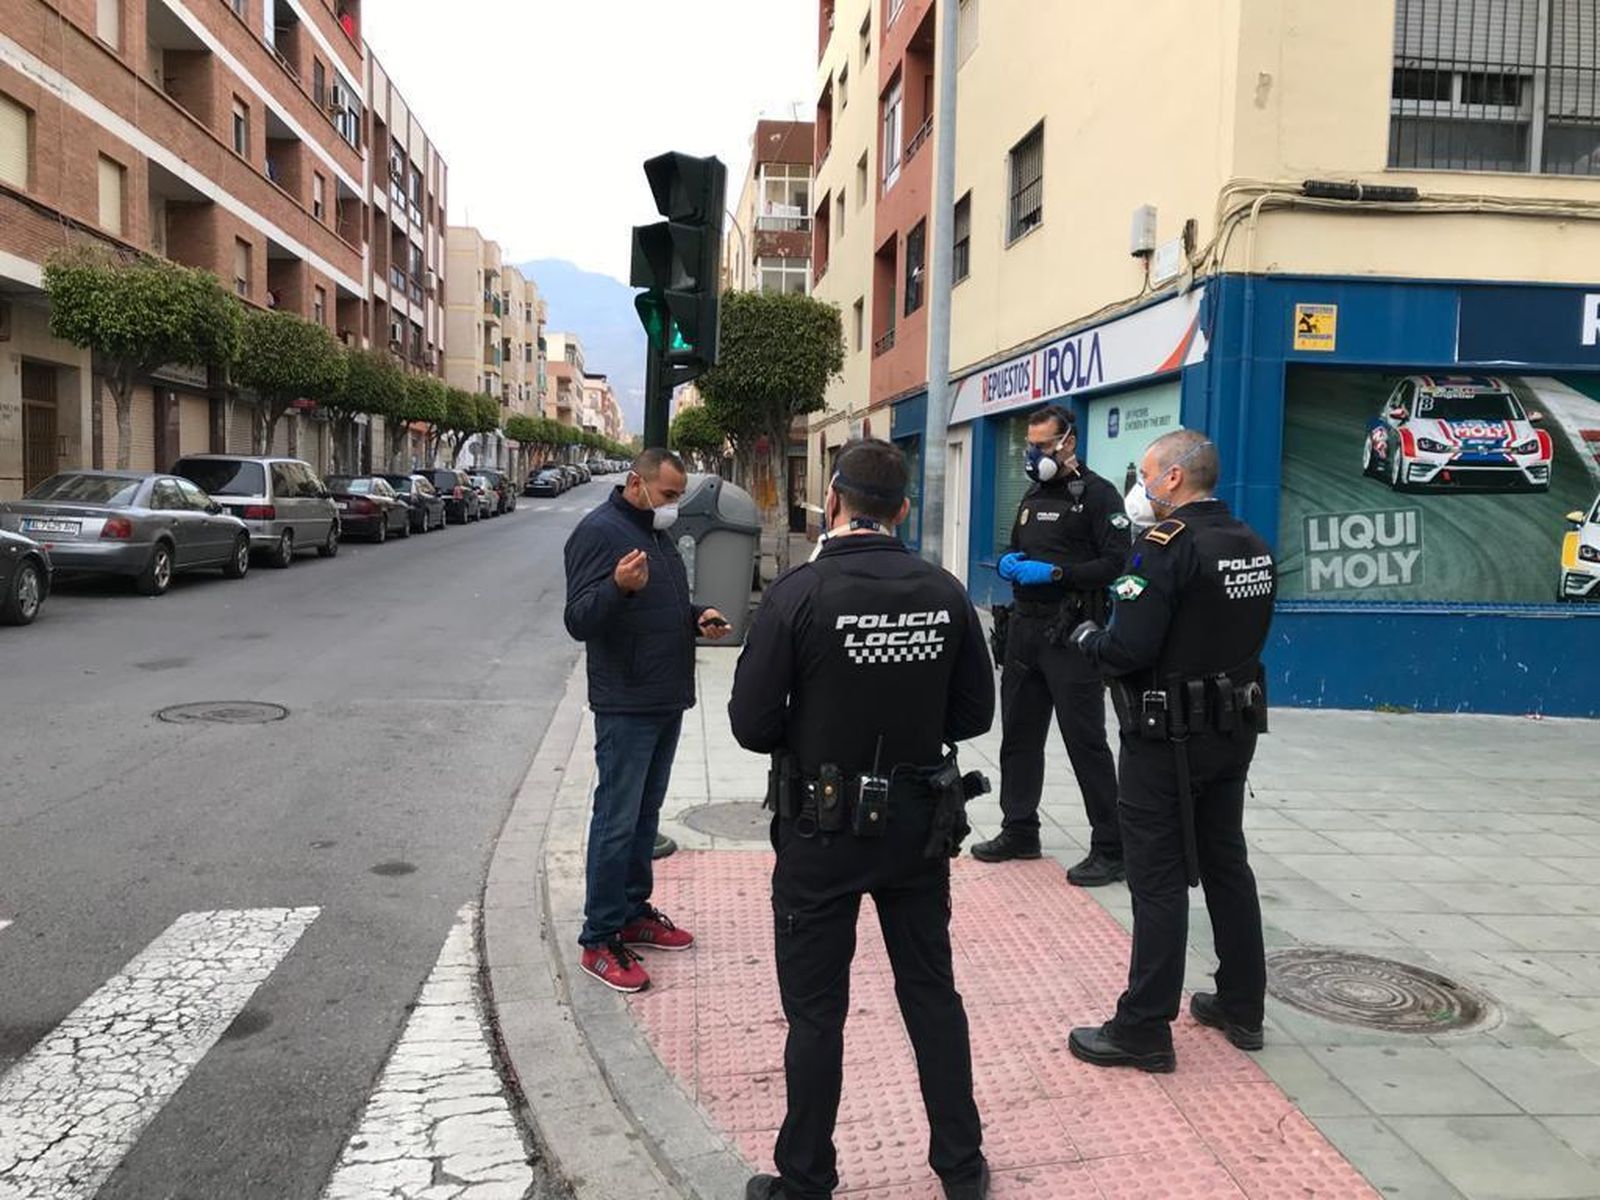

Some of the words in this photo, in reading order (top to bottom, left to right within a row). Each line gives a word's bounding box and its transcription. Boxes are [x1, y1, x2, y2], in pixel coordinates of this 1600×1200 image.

[982, 359, 1031, 403] REPUESTOS
[1032, 332, 1103, 399] LIROLA
[1455, 426, 1506, 438] MOLY
[1309, 511, 1416, 550] LIQUI
[1218, 555, 1272, 571] POLICIA
[1311, 550, 1420, 590] MOLY
[1225, 569, 1272, 586] LOCAL
[836, 610, 951, 629] POLICIA
[844, 630, 944, 647] LOCAL
